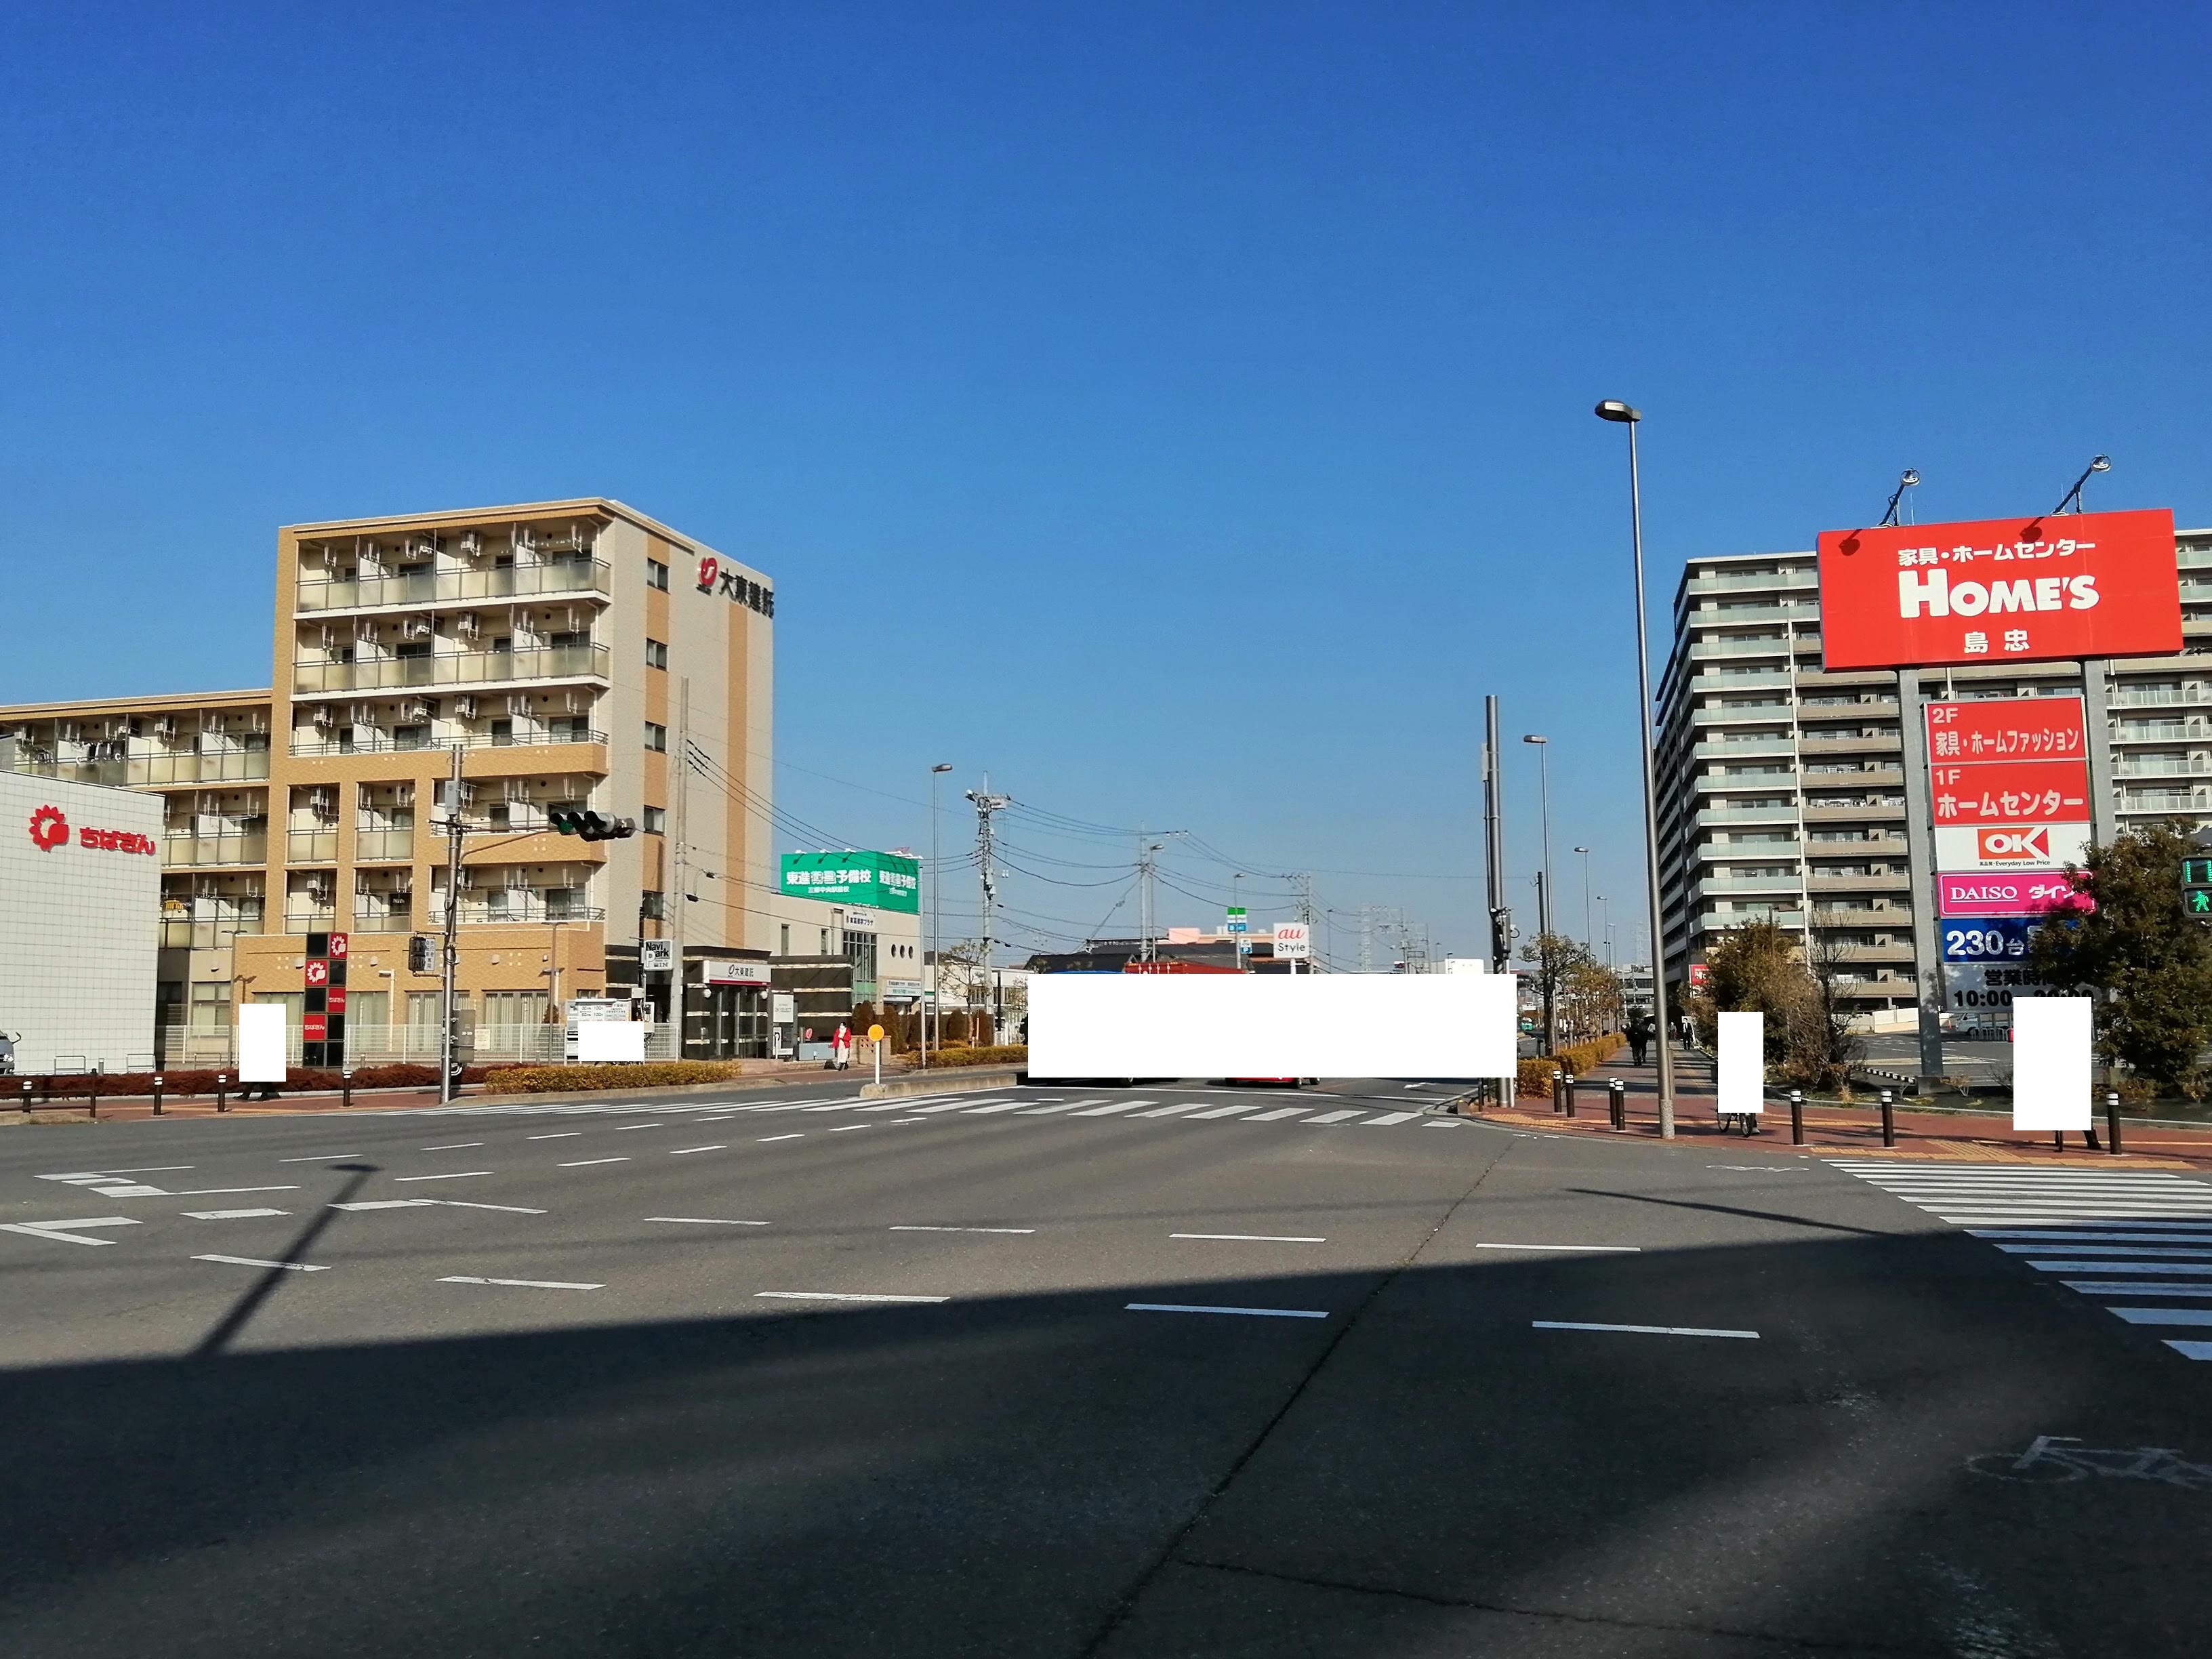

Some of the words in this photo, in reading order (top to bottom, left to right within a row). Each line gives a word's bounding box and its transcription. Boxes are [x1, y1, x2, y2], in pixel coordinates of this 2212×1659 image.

[1898, 538, 2096, 567] 家具・ホームセンター
[718, 568, 775, 619] 大東建託
[1898, 568, 2100, 619] HOME'S
[1932, 708, 1959, 724] 2F
[1935, 727, 2079, 757] 家具・ホームファッション
[1936, 769, 1961, 785] 1F
[1937, 789, 2084, 819] ホームセンター
[79, 827, 155, 856] ちばぎん
[1985, 827, 2049, 859] OK
[786, 869, 872, 885] 東進衛星予備校
[1950, 886, 2018, 901] DAISO
[646, 942, 663, 951] Navi
[1278, 928, 1305, 939] au
[1946, 930, 2025, 956] 230台
[1278, 943, 1306, 952] Style
